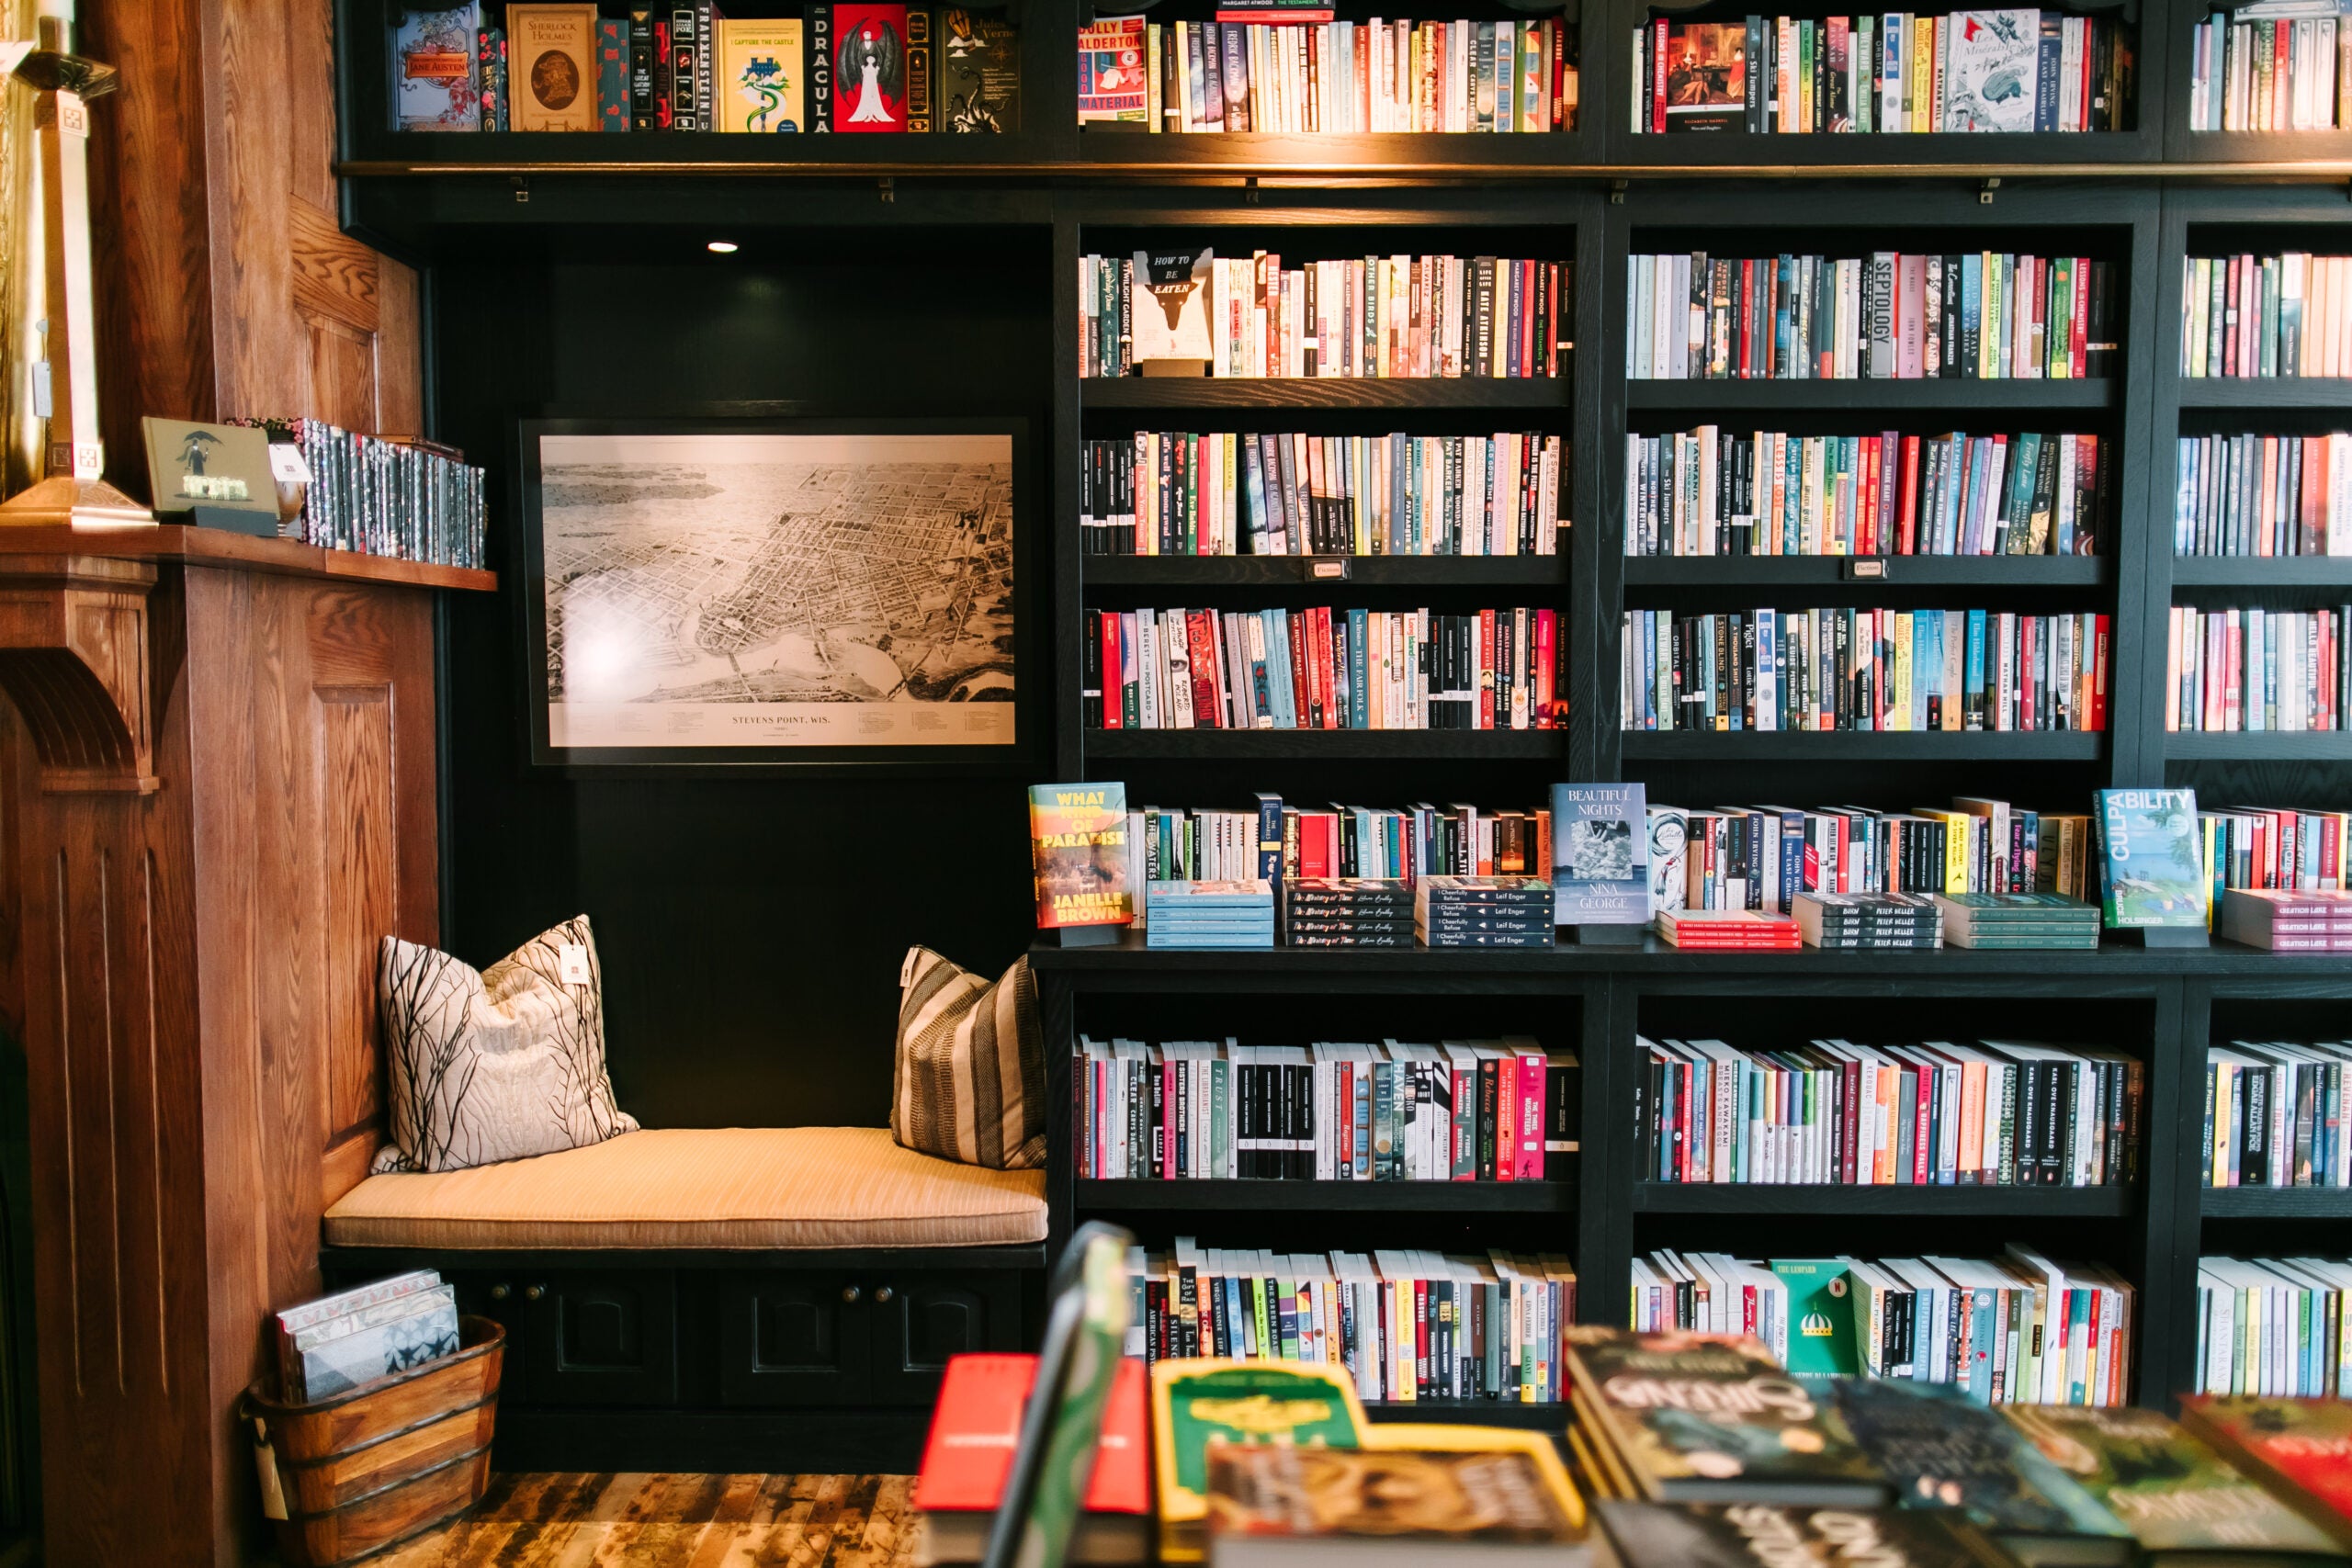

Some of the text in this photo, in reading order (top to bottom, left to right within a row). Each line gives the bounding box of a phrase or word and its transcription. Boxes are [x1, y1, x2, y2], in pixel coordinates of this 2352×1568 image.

[528, 21, 577, 30] SHERLOCK
[533, 31, 572, 40] HOLMES
[983, 29, 1015, 39] Verne
[1917, 20, 1926, 56] HIJUELOS
[1079, 36, 1141, 49] ALDERTON
[1206, 26, 1216, 69] FREDRIK BACKMAN
[1828, 27, 1837, 62] HANNAH
[432, 62, 464, 71] AUSTEN
[699, 7, 709, 108] FRANKENSTEIN
[1227, 30, 1241, 86] FREDRIK BACKMAN
[1657, 24, 1666, 96] LESSONS CHEMISTRY
[1779, 28, 1789, 94] LESS IS LOST
[1874, 40, 1883, 75] ORBITAL
[813, 19, 831, 133] DRACULA
[1748, 61, 1758, 108] Ski Jumpers
[1936, 68, 1944, 101] NATHAN
[1080, 96, 1143, 109] MATERIAL
[1154, 255, 1190, 265] HOW TO
[1165, 270, 1178, 279] BE
[1268, 265, 1278, 296] HESTER
[1155, 284, 1190, 294] EATEN
[1367, 259, 1376, 323] OTHER BIRDS
[1873, 262, 1891, 344] SEPTOLOGY
[1478, 291, 1489, 357] KATE ATKINSON
[1531, 435, 1539, 454] TENDER
[1531, 464, 1539, 474] THE
[2020, 442, 2034, 488] Firefly Lane
[1530, 475, 1539, 491] FLESH
[1547, 445, 1559, 542] Big Swiss Jen Beagin
[1663, 492, 1671, 525] Jumpers
[1659, 625, 1670, 662] WEYWARD
[2307, 620, 2317, 691] HELLO BEAUTIFUL
[732, 716, 831, 726] STEVENS POINT, WIS.
[1057, 791, 1104, 806] WHAT
[1568, 790, 1631, 802] BEAUTIFUL
[2124, 792, 2190, 809] BILITY
[1060, 806, 1103, 818] KIND
[1578, 805, 1623, 816] NIGHTS
[1042, 831, 1125, 848] PARADISE
[1071, 819, 1093, 832] OF
[2107, 793, 2131, 862] CULPA
[1148, 840, 1156, 879] WATERS
[1053, 892, 1123, 909] JANELLE
[1510, 893, 1526, 902] Enger
[1580, 897, 1627, 909] GEORGE
[1589, 884, 1618, 895] NINA
[2115, 889, 2125, 916] BRUCE
[1057, 907, 1121, 923] BROWN
[1215, 1068, 1224, 1111] TRUST
[1393, 1064, 1404, 1111] HAVEN
[2315, 1066, 2324, 1112] Bewilderment
[2331, 1065, 2339, 1089] Annie
[1485, 1077, 1494, 1112] Rebecca
[1918, 1112, 1928, 1174] HAPPINESS FALLS
[1268, 1296, 1276, 1326] GREEN
[1950, 1292, 1958, 1319] HARPER
[1270, 1329, 1278, 1350] ROAD
[1883, 1325, 1892, 1348] WINTER
[1918, 1294, 1928, 1372] INDEPENDENT PEOPLE
[1977, 1310, 1986, 1349] PACHINKO
[2218, 1309, 2229, 1382] SHANTARAM
[1524, 1355, 1532, 1374] GIANT
